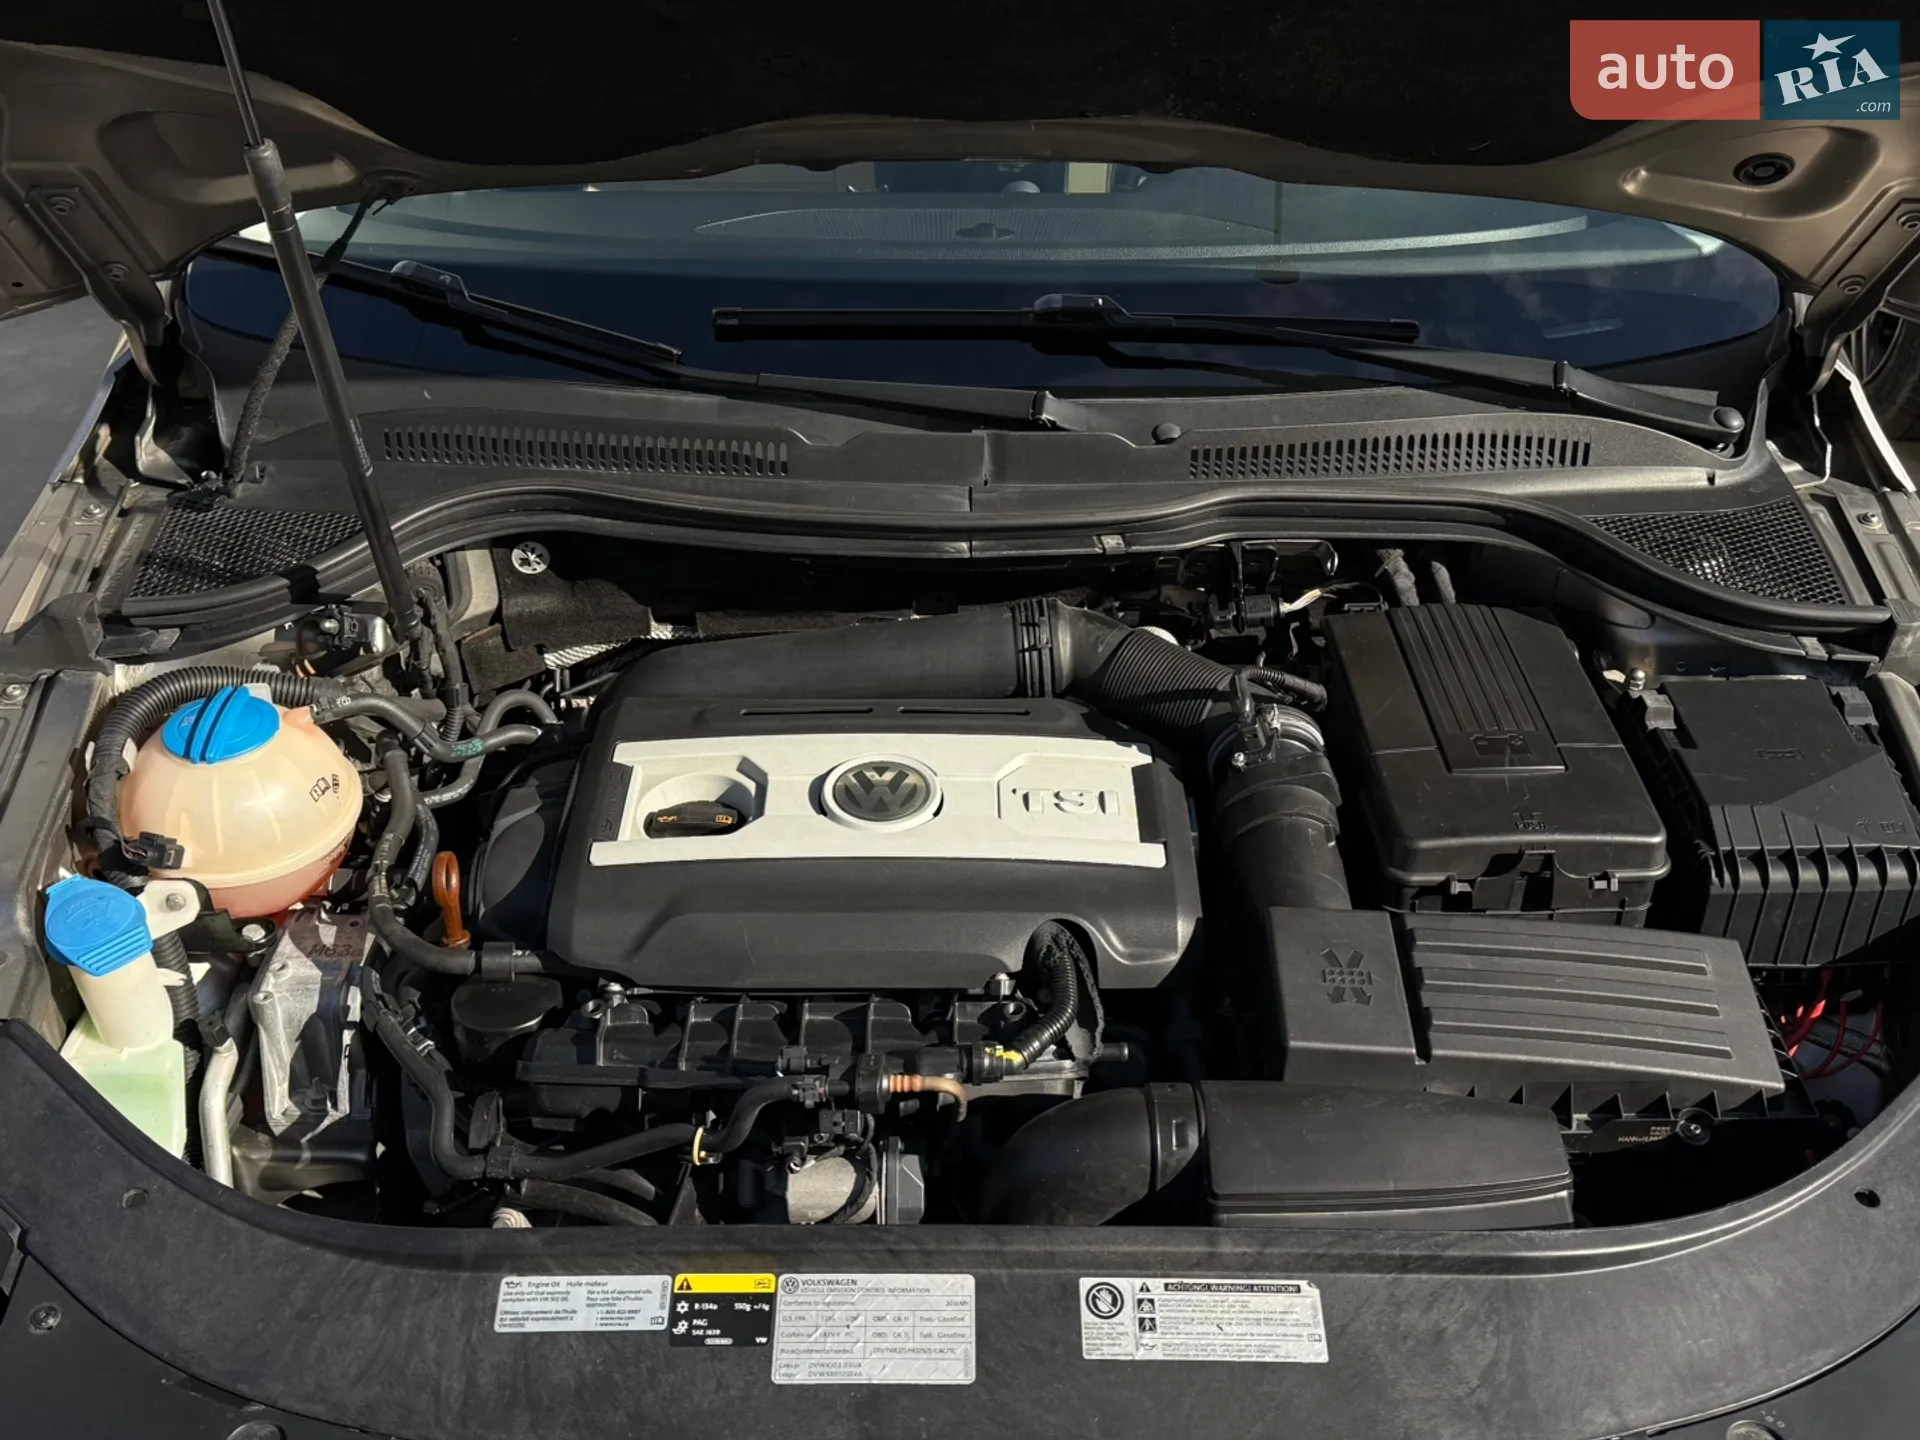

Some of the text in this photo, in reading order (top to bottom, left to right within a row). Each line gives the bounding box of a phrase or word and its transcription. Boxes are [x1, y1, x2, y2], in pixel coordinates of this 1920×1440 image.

[1012, 788, 1120, 815] TSI
[528, 1281, 550, 1289] Engine
[801, 1278, 857, 1286] VOLKSWAGEN
[1167, 1283, 1208, 1291] ACHTUNG!
[1210, 1284, 1251, 1292] WARNING!
[694, 1302, 718, 1310] R-134a
[692, 1318, 708, 1326] PAG
